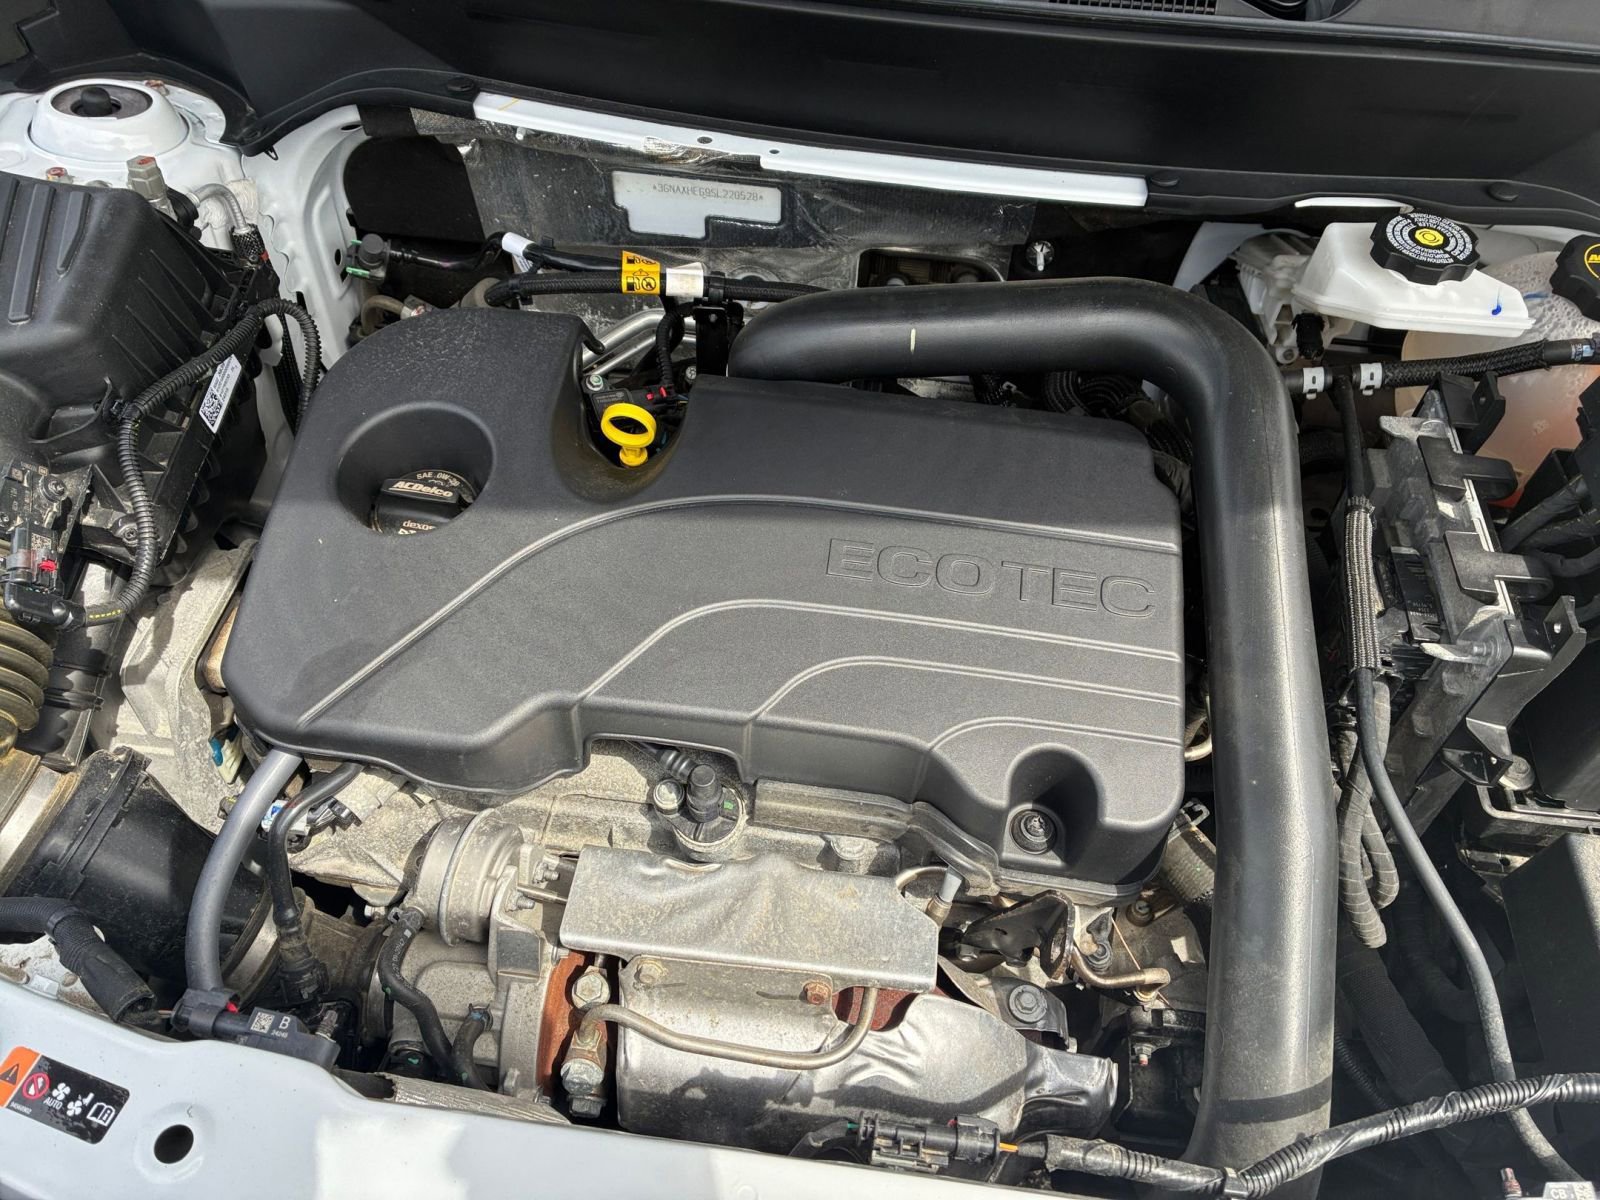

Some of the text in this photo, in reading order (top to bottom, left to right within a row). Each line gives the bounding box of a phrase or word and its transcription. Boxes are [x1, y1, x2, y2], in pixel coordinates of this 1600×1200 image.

[416, 472, 434, 480] SAE
[393, 480, 454, 497] ACDelco
[825, 538, 1156, 619] ECOTEC
[279, 1015, 291, 1030] B
[43, 1096, 63, 1110] AUTO
[1550, 1188, 1567, 1199] CB
